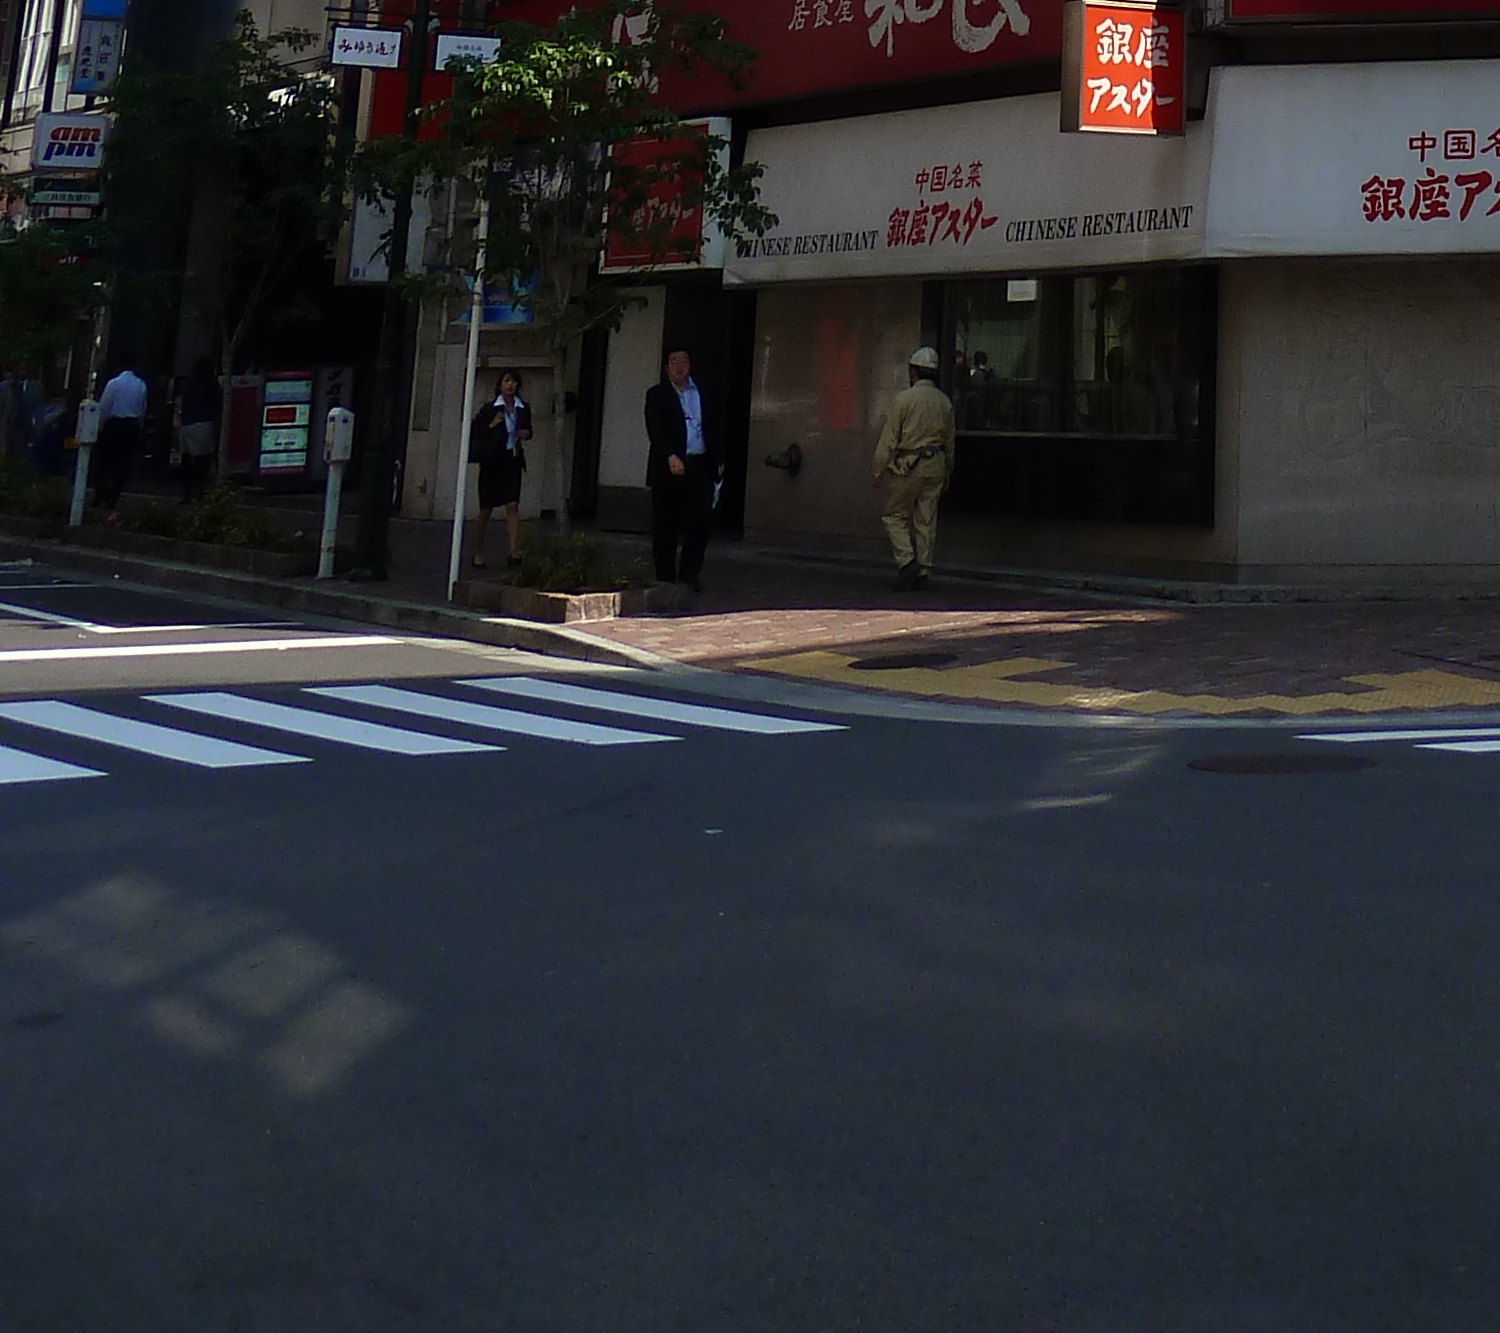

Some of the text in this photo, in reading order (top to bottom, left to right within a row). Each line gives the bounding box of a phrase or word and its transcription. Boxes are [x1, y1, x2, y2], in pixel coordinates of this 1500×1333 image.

[1096, 18, 1171, 69] 銀座
[1087, 76, 1177, 118] アスター
[43, 141, 96, 161] pm
[51, 126, 101, 142] am
[915, 161, 984, 195] 中国名菜
[887, 196, 999, 248] 銀座アスター
[1006, 205, 1193, 243] CHINESE RESTAURANT
[793, 230, 879, 256] RESTAURANT
